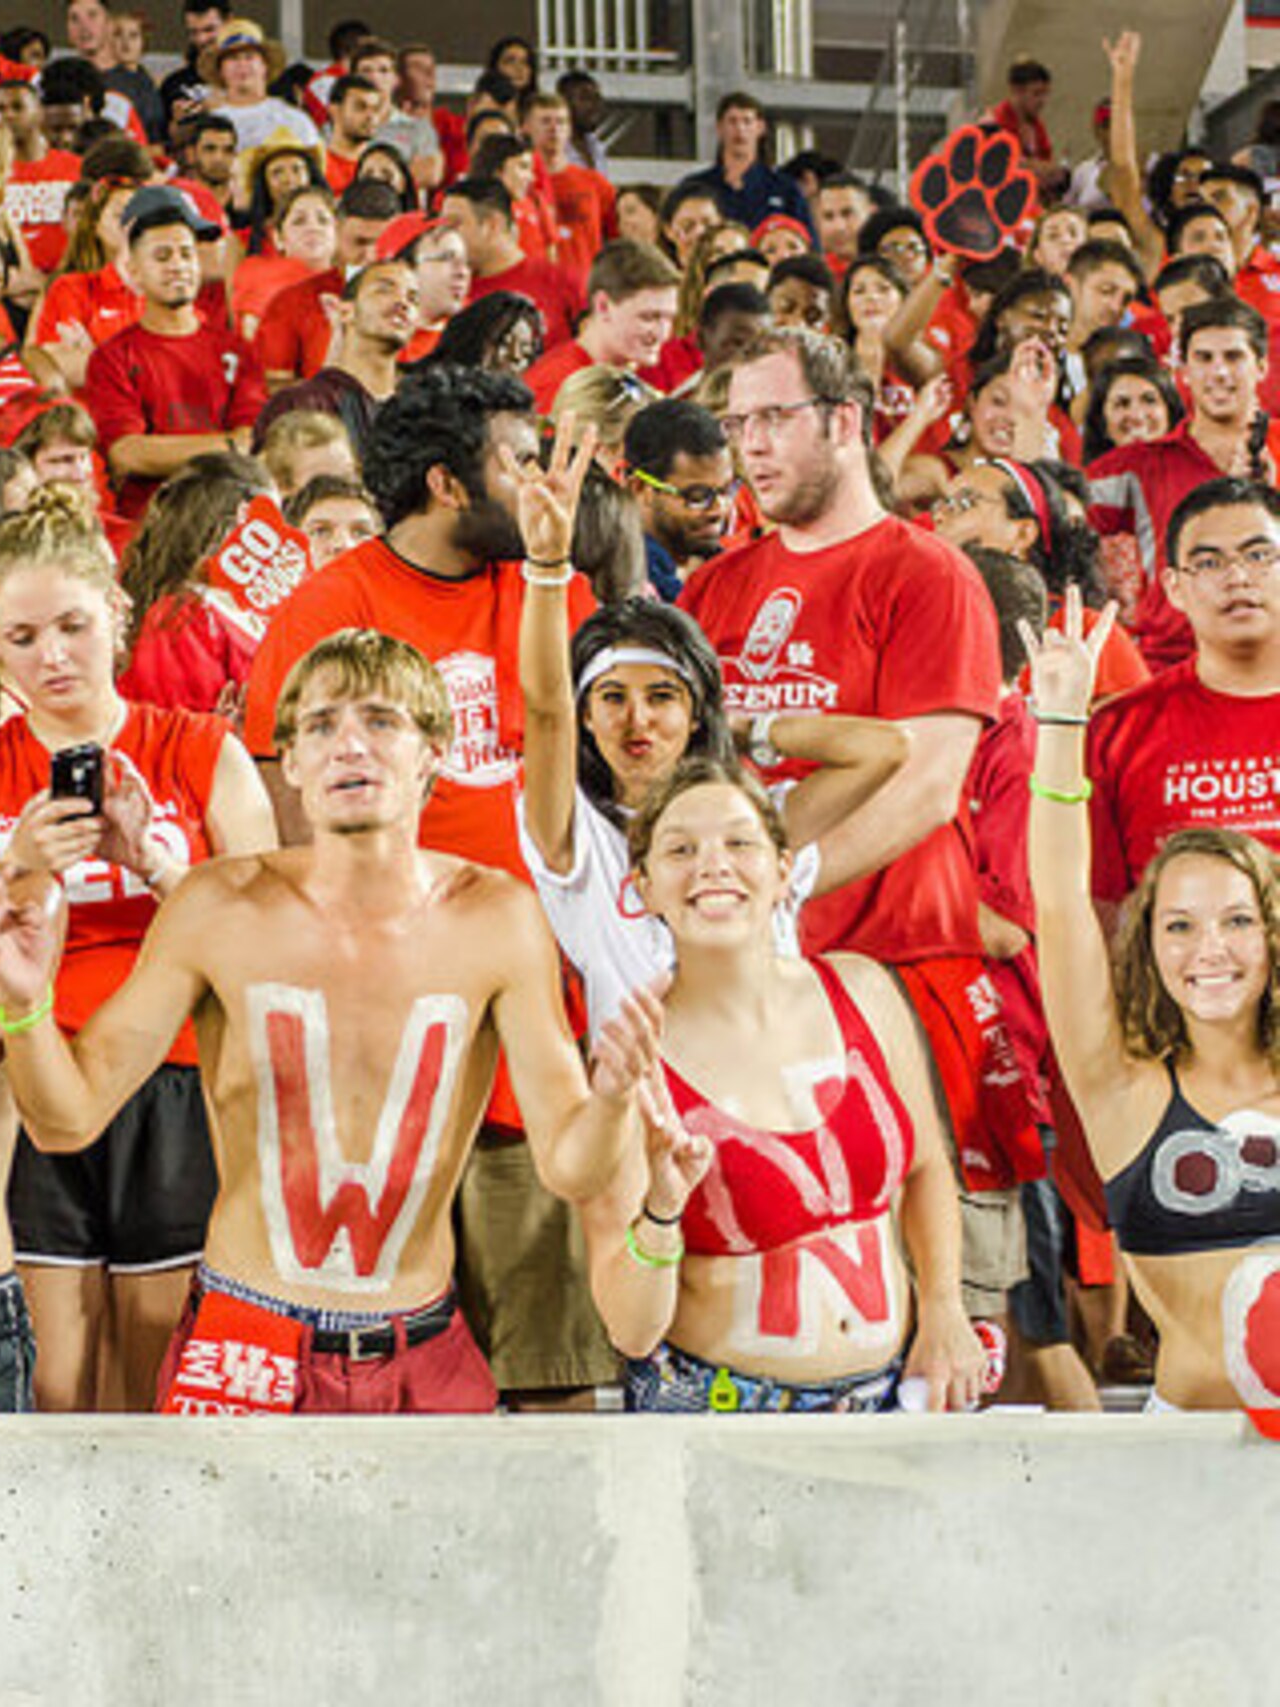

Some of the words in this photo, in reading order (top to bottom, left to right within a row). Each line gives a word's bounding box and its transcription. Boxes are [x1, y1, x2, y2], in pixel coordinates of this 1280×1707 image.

[220, 519, 281, 585] GO
[722, 682, 839, 708] EENUM
[246, 981, 468, 1292] W
